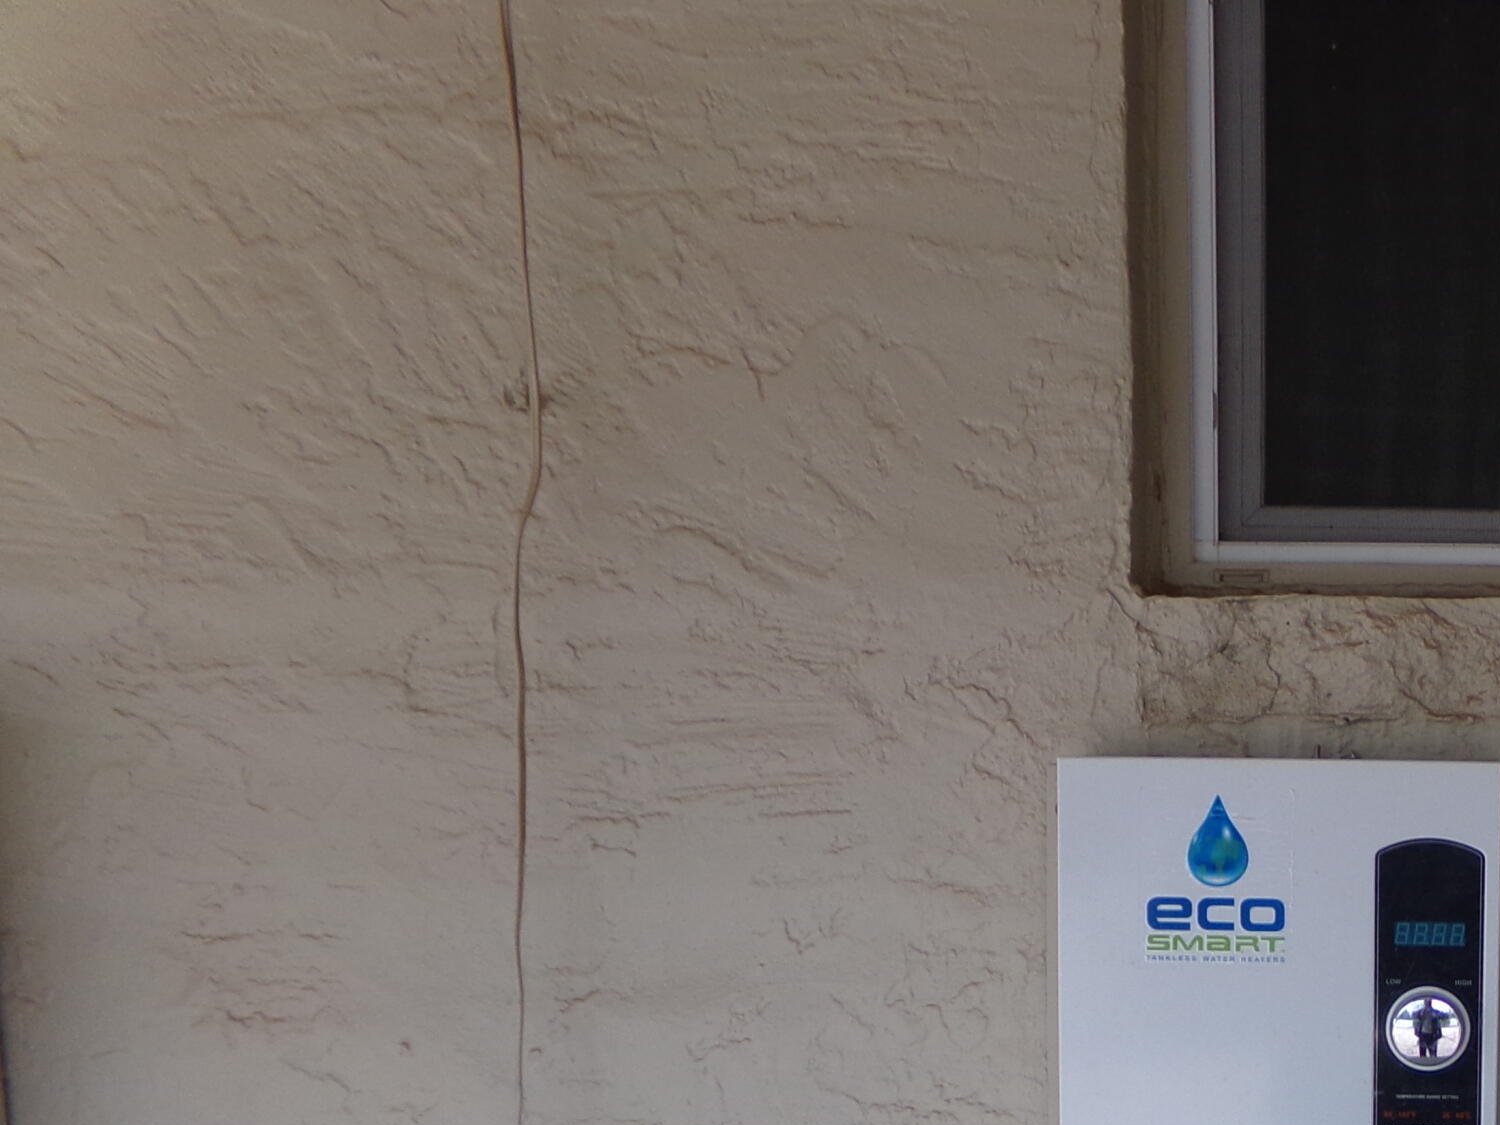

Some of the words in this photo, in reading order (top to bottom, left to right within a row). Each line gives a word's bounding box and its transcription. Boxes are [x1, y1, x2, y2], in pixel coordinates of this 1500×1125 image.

[1146, 896, 1286, 932] eco
[1146, 955, 1197, 963] TANKLESS
[1202, 955, 1236, 964] WATER
